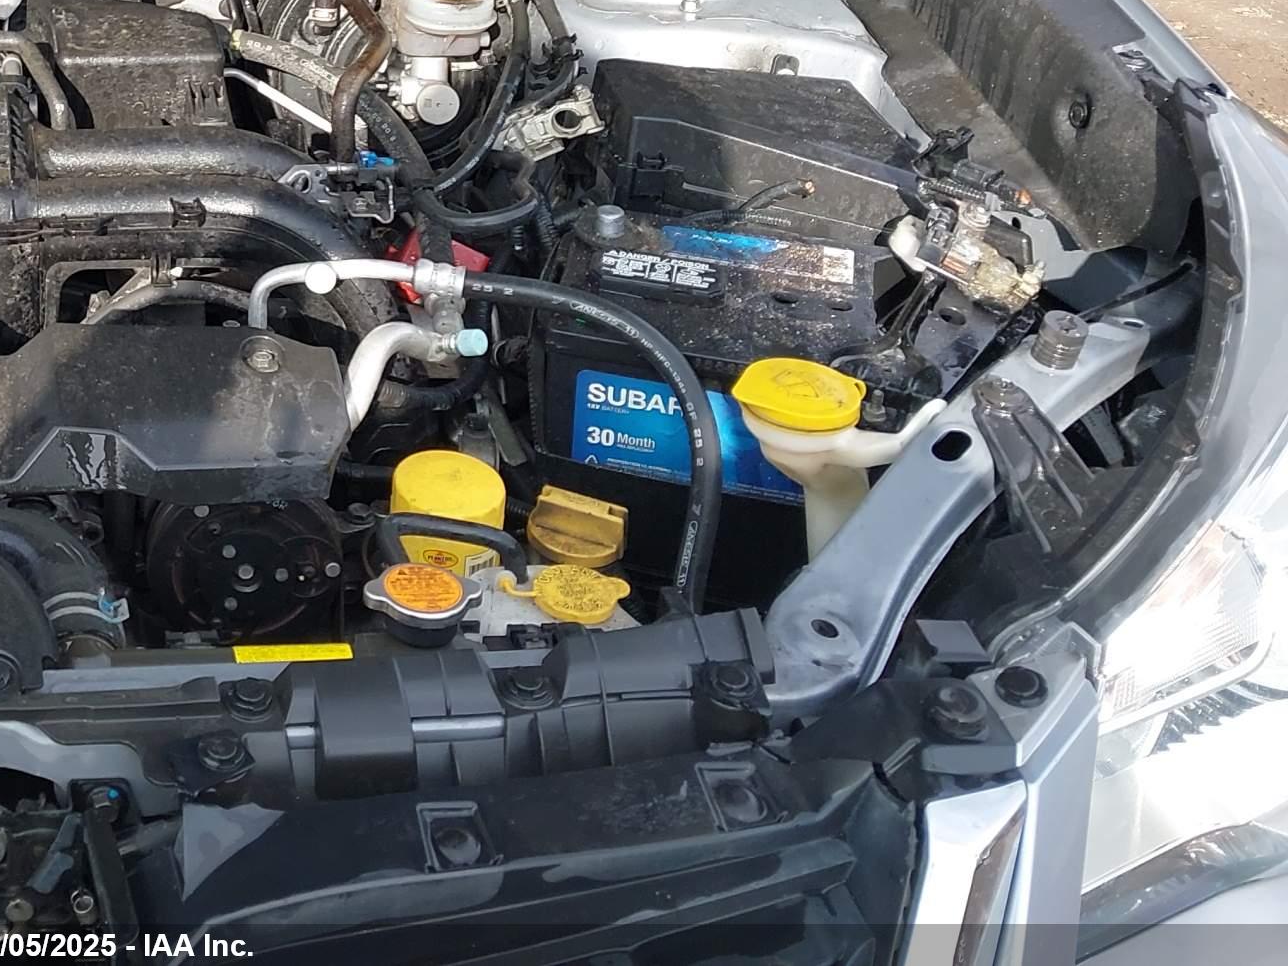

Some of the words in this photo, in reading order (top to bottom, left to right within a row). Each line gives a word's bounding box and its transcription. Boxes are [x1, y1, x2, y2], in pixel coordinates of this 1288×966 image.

[619, 250, 661, 263] DANGER
[670, 258, 709, 270] POISON
[472, 283, 494, 293] 25
[503, 287, 514, 296] 2
[587, 383, 683, 417] SUBAR
[587, 426, 615, 446] 30
[617, 432, 656, 449] Month
